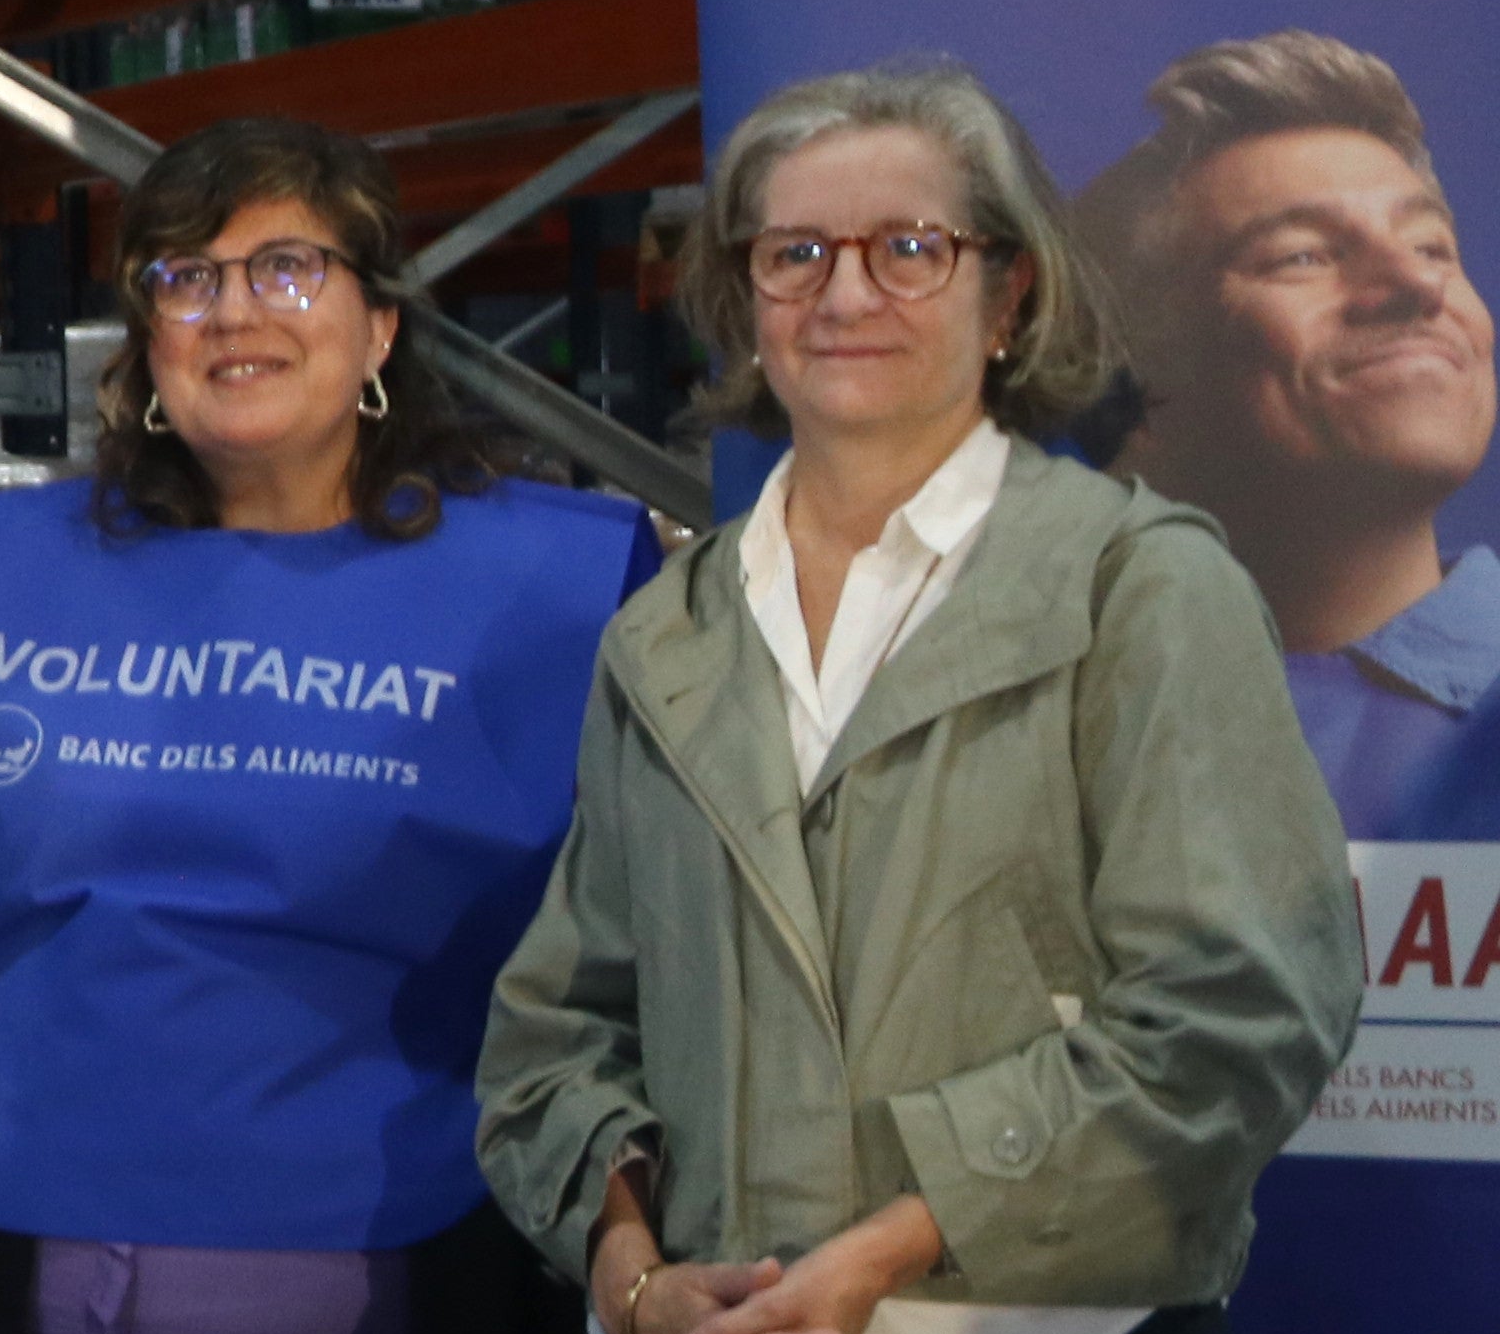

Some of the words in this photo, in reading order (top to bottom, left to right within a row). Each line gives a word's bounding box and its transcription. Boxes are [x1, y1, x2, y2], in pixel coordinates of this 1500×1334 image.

[58, 735, 151, 768] BANC
[159, 744, 237, 771] DELS
[245, 745, 420, 786] ALIMENTS
[1380, 1068, 1474, 1091] BANCS
